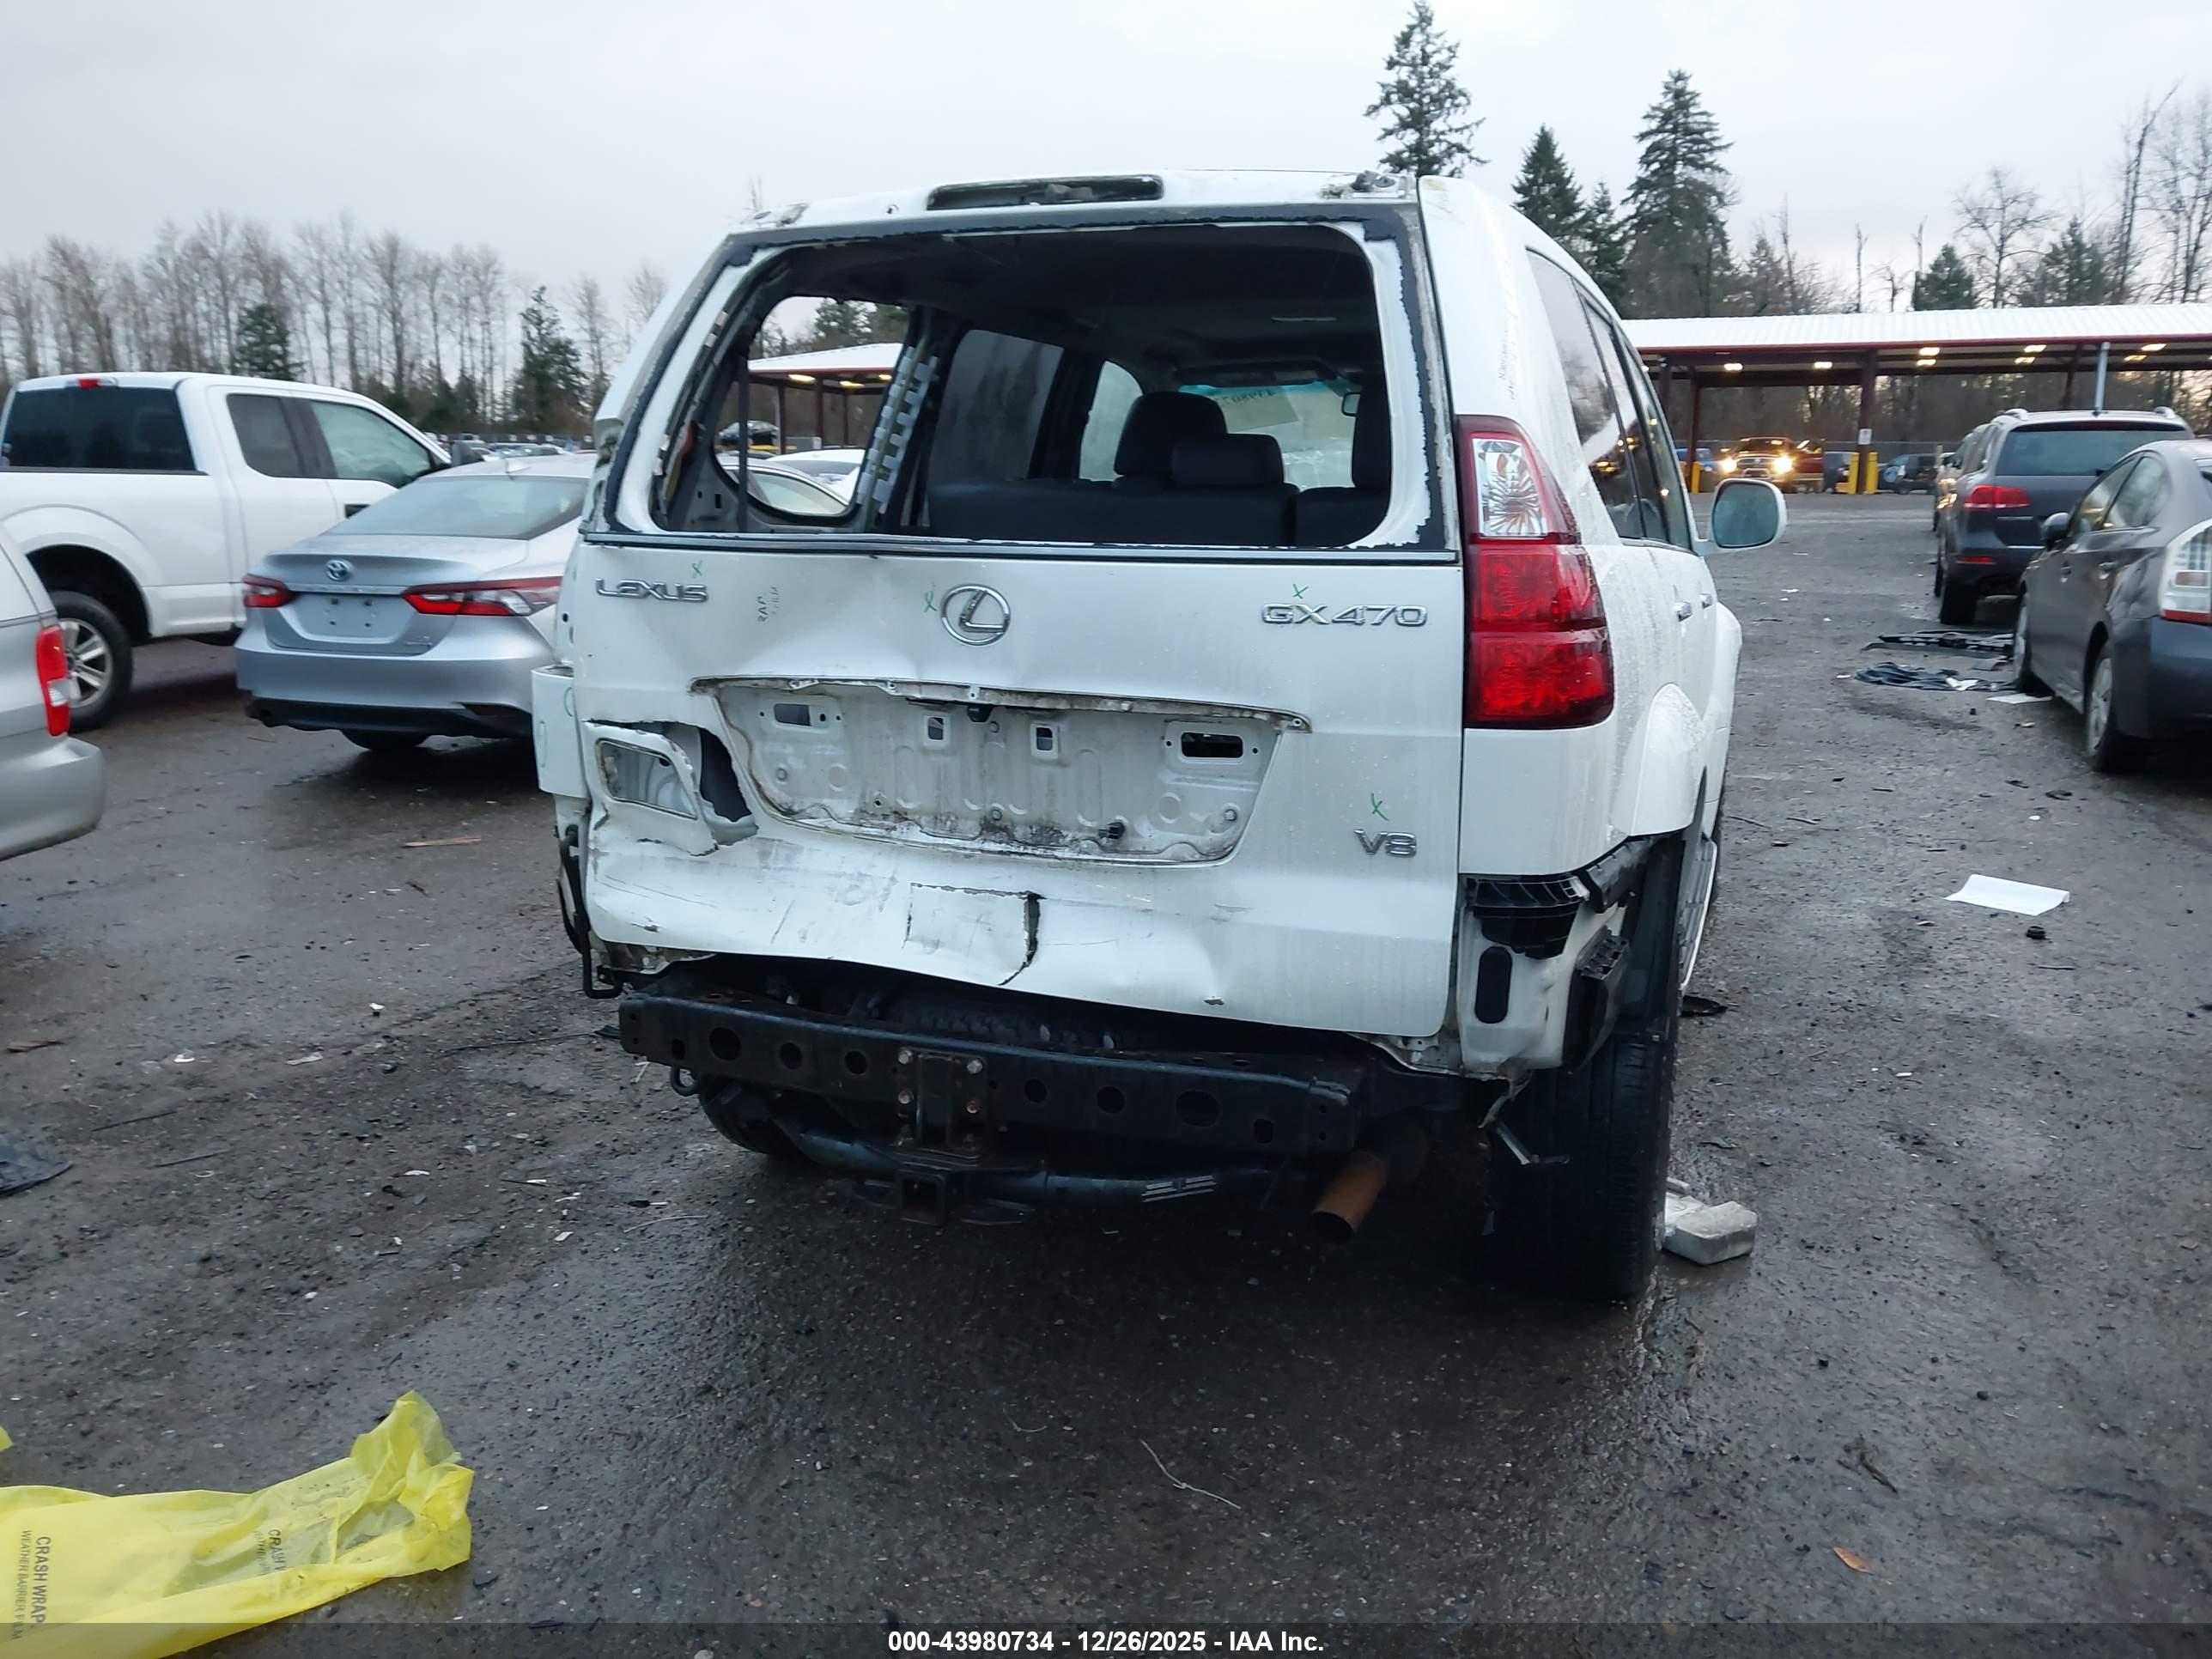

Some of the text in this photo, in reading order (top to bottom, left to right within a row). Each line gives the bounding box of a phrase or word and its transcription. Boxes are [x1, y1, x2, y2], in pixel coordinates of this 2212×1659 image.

[596, 578, 708, 603] LEXUS
[1261, 604, 1428, 628] GX470
[1353, 828, 1418, 858] V8
[20, 1529, 32, 1571] WEATHER
[14, 1573, 29, 1611] BARRIER
[31, 1535, 52, 1624] CRASH WRAP
